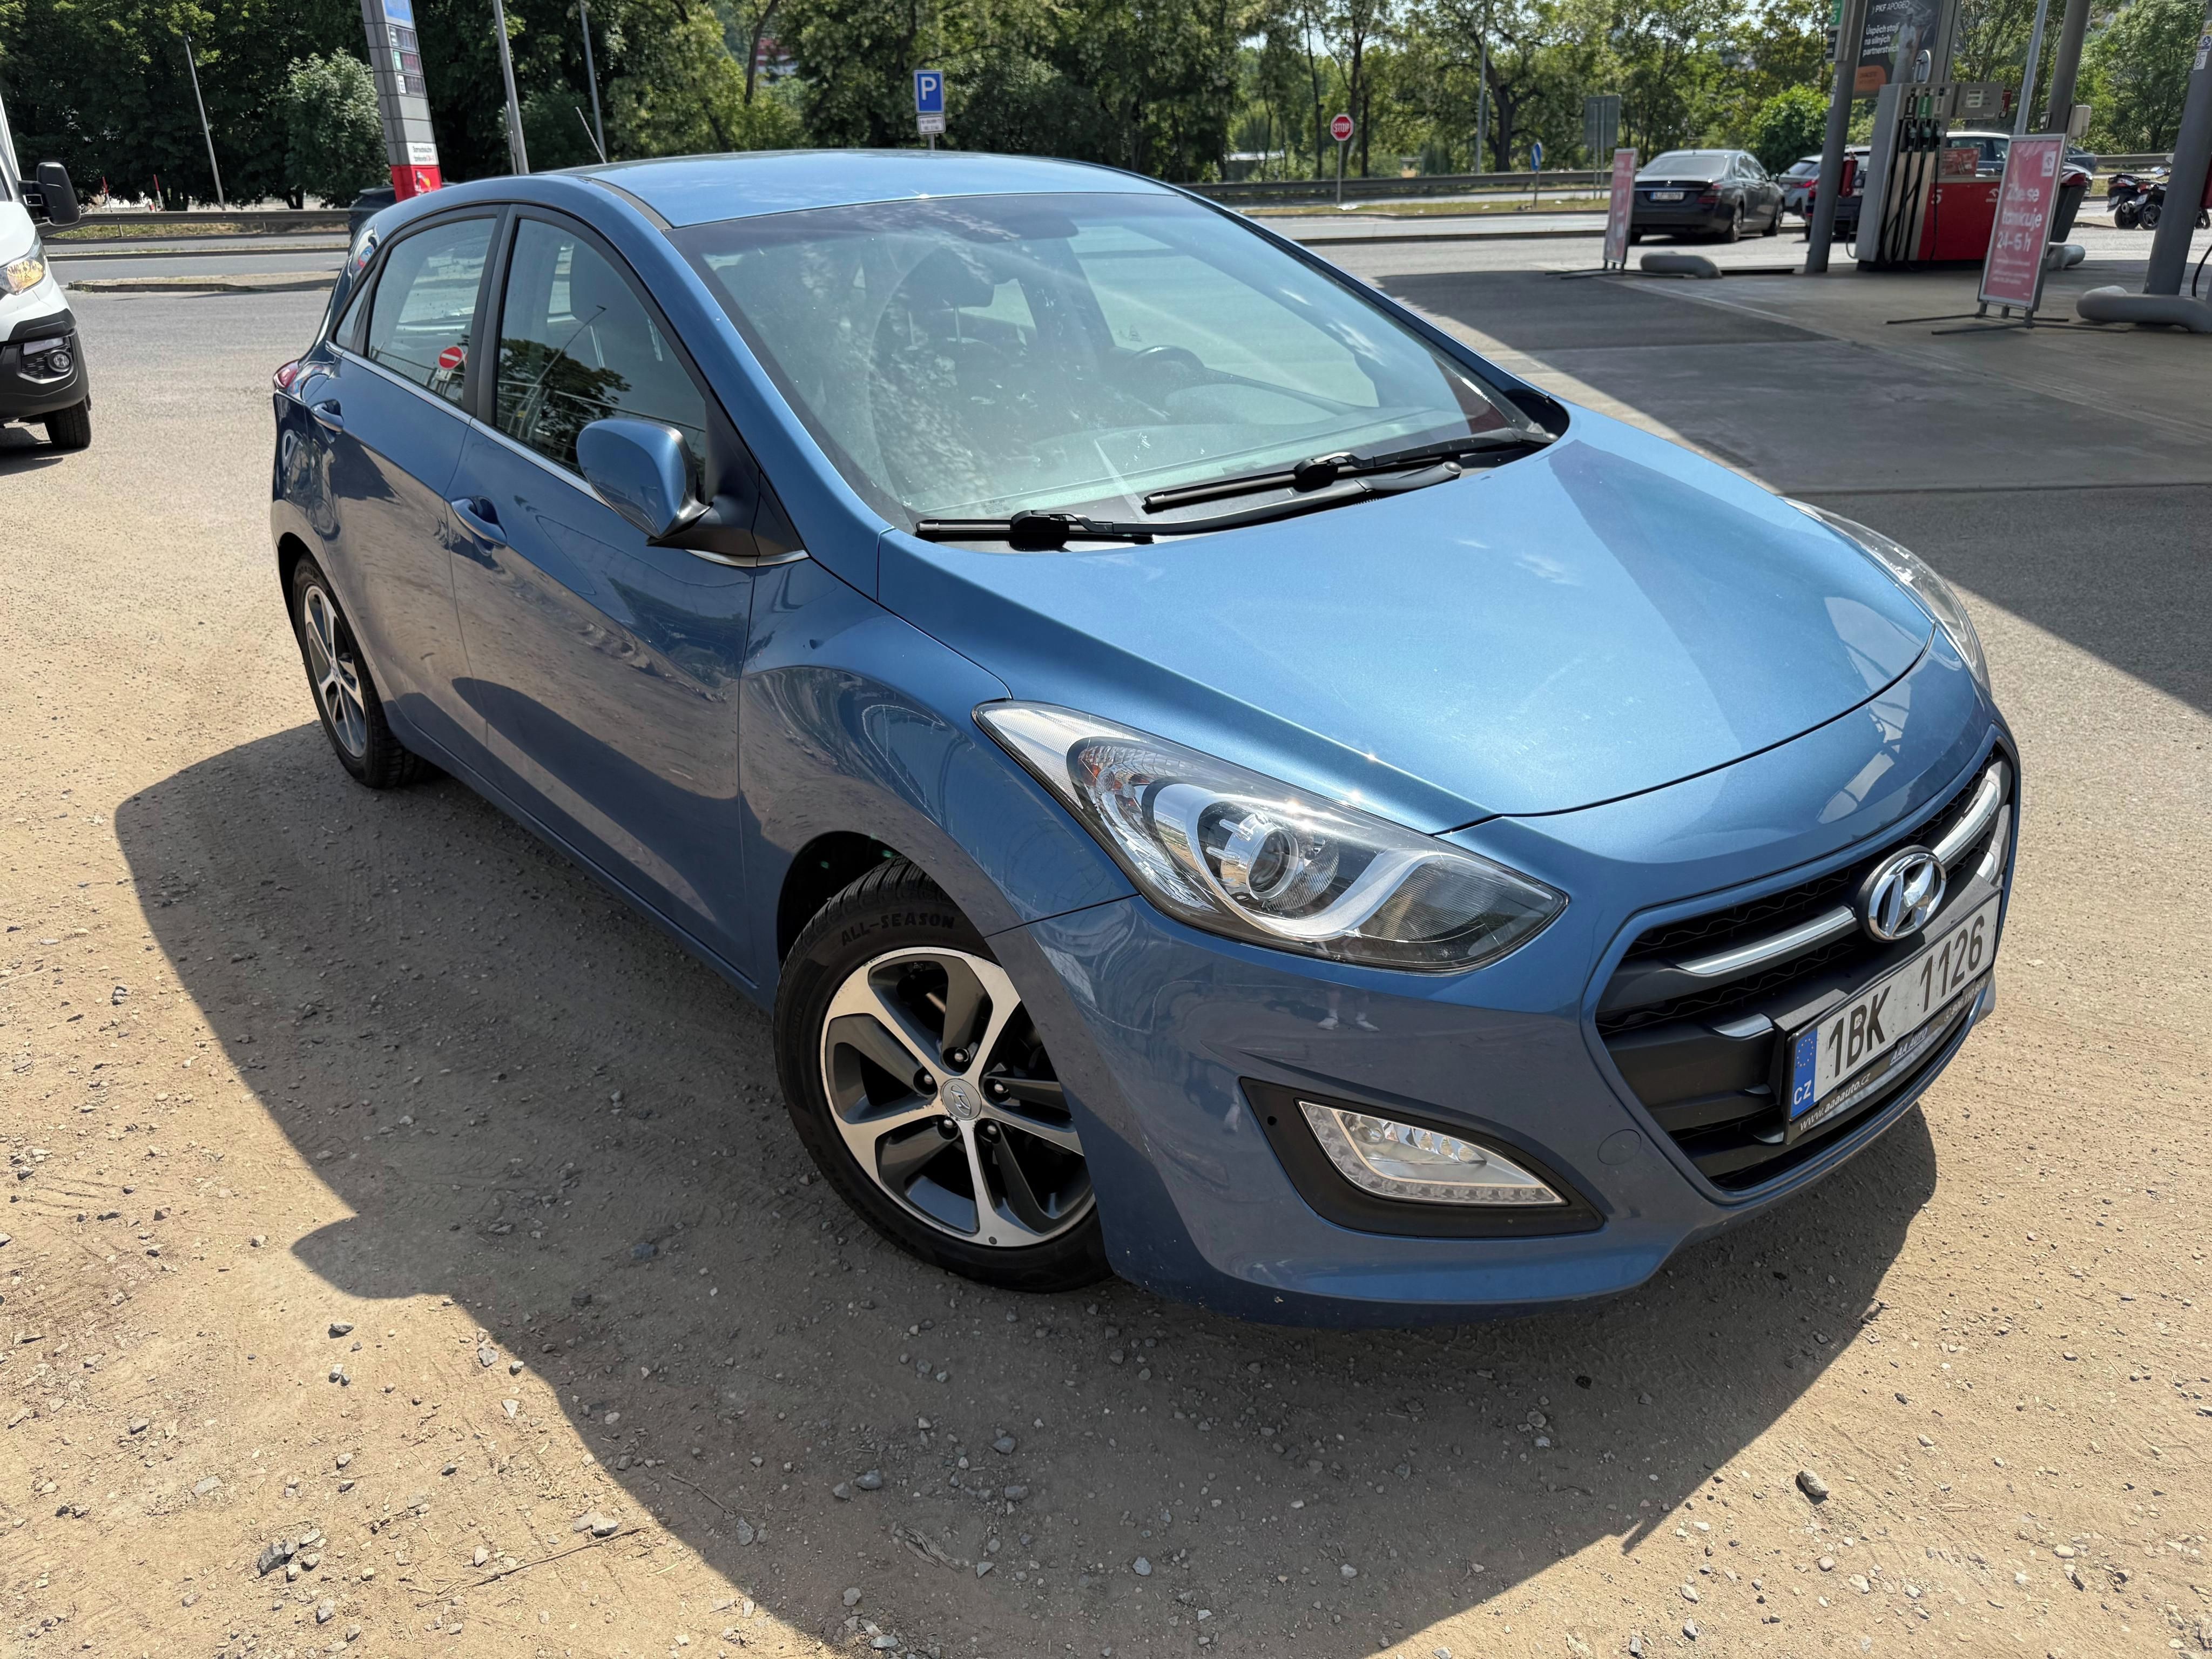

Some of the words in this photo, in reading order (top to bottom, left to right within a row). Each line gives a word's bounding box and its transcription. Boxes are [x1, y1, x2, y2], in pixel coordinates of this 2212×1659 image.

[1875, 4, 1887, 12] PKF
[921, 77, 937, 100] P
[1333, 123, 1350, 133] STOP
[1931, 189, 1943, 205] 5
[2027, 187, 2039, 203] se
[2023, 232, 2031, 252] h
[840, 912, 955, 946] ALL-SEASON
[1828, 985, 1891, 1078] 1BK
[1920, 915, 1985, 1013] 1126
[1891, 1043, 1908, 1062] AAA
[1908, 1027, 1928, 1049] AUTO
[1793, 1080, 1812, 1105] CZ
[1800, 1073, 1871, 1131] www.aaaauto.cz
